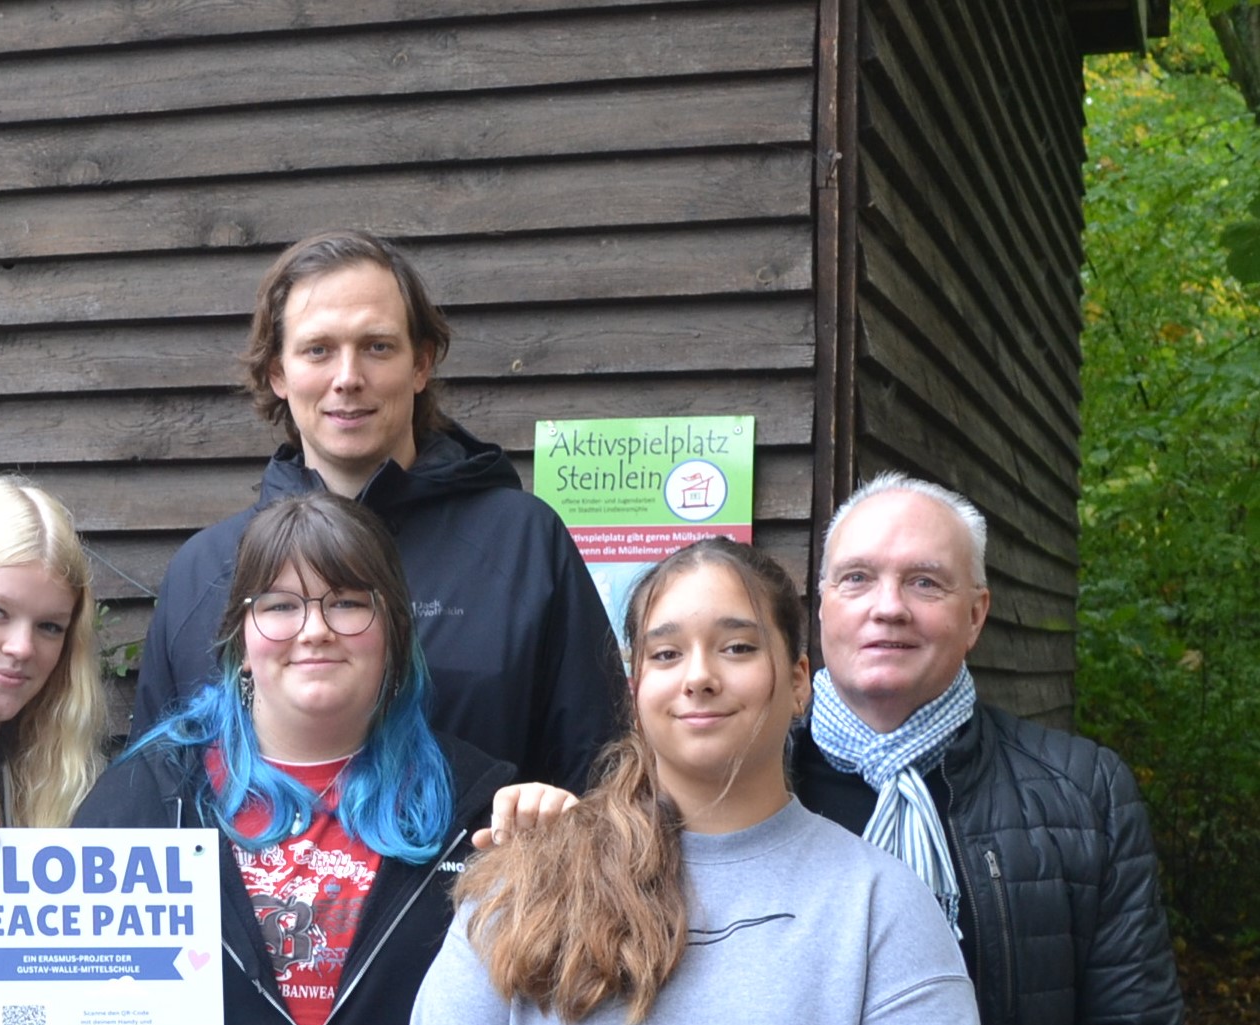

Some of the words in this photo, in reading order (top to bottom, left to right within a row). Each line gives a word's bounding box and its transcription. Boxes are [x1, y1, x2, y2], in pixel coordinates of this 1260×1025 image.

[549, 425, 729, 464] Aktivspielplatz
[556, 459, 662, 491] Steinlein
[627, 531, 644, 543] gibt
[646, 533, 671, 543] gerne
[603, 545, 617, 555] die
[618, 544, 662, 555] Mülleimer
[92, 904, 194, 936] PATH
[23, 955, 37, 963] EIN
[38, 954, 114, 963] ERASMUS-PROJEKT
[115, 954, 132, 963] DER
[16, 965, 140, 974] GUSTAV-WALLE-MITTELSCHULE
[278, 984, 338, 999] BANWEA
